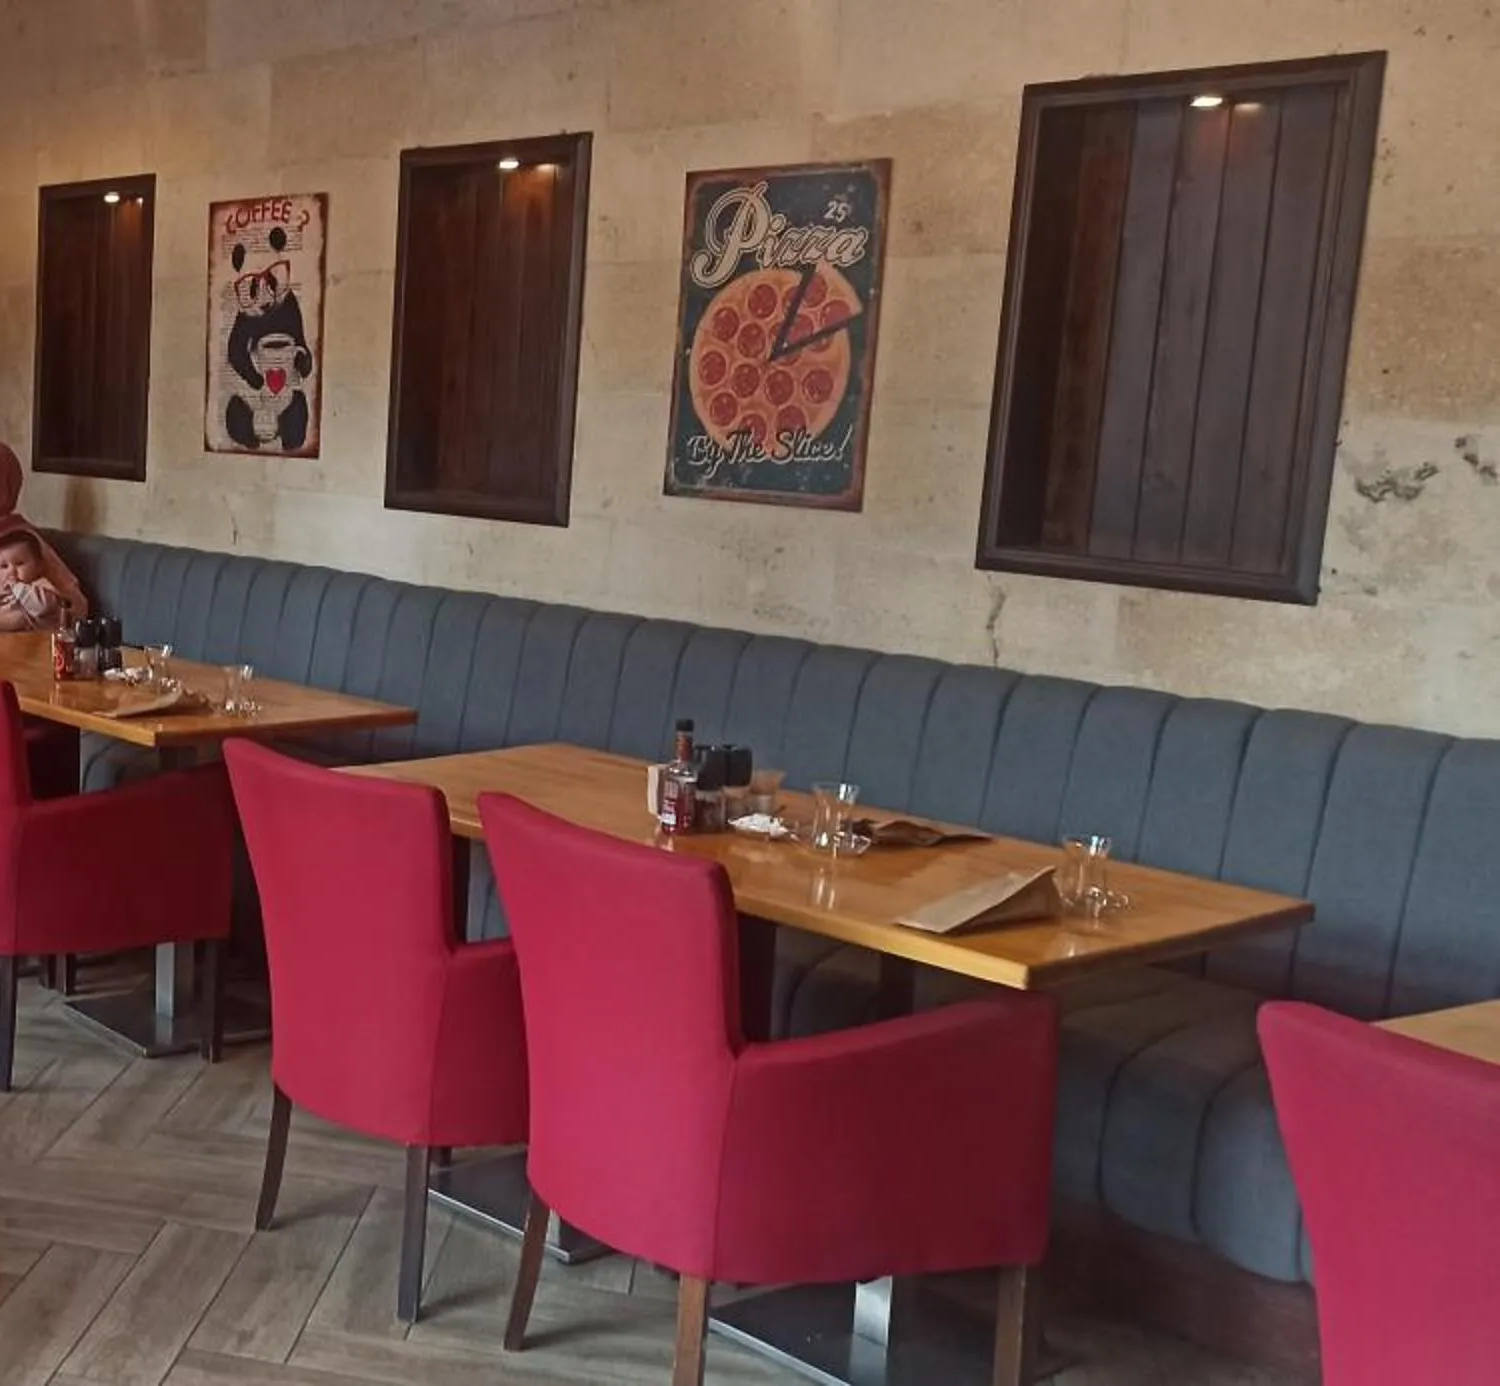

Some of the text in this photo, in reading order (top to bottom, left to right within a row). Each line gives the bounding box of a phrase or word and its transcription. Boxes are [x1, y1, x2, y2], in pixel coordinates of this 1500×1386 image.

[689, 180, 870, 289] Pizza
[686, 433, 725, 480] By
[725, 428, 767, 465] The
